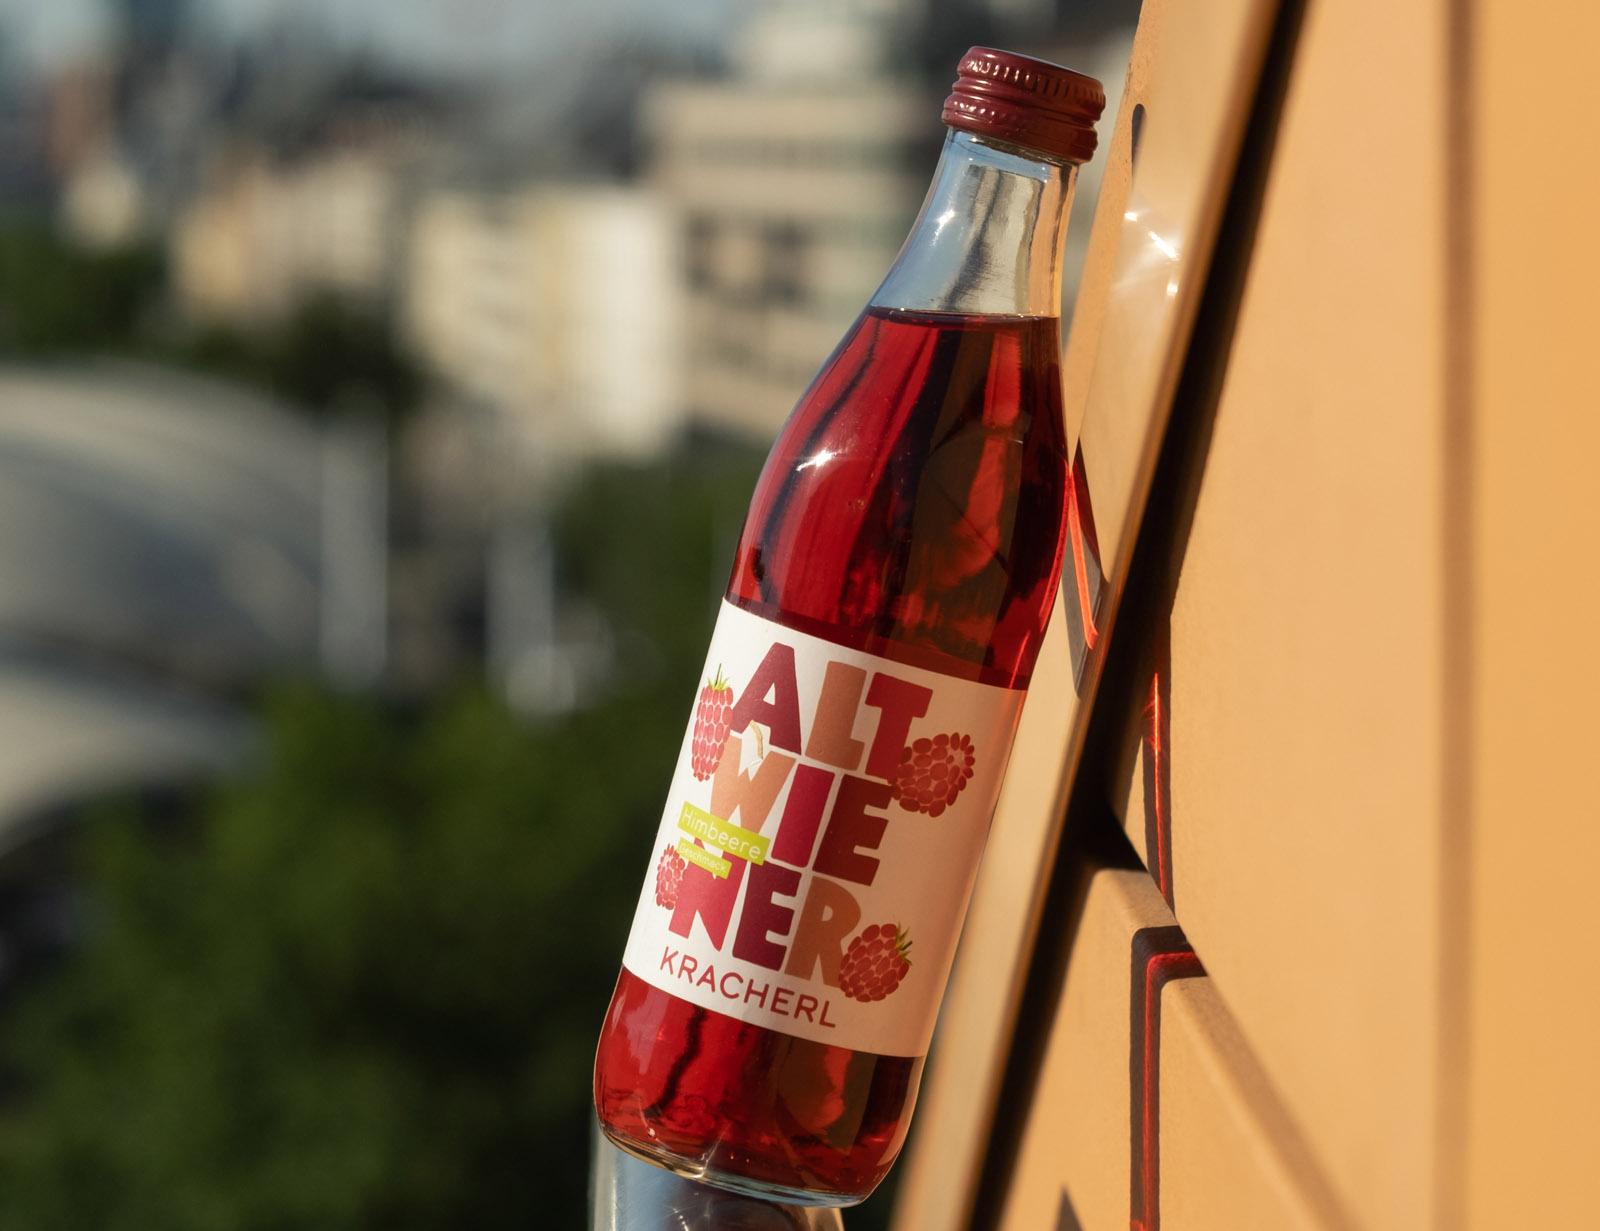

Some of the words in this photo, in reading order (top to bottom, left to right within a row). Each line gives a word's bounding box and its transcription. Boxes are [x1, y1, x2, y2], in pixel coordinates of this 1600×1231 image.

[730, 641, 934, 783] ALT
[682, 810, 761, 859] Himbeere
[710, 736, 897, 886] WIE
[668, 836, 862, 987] NER
[660, 946, 836, 1028] KRACHERL
